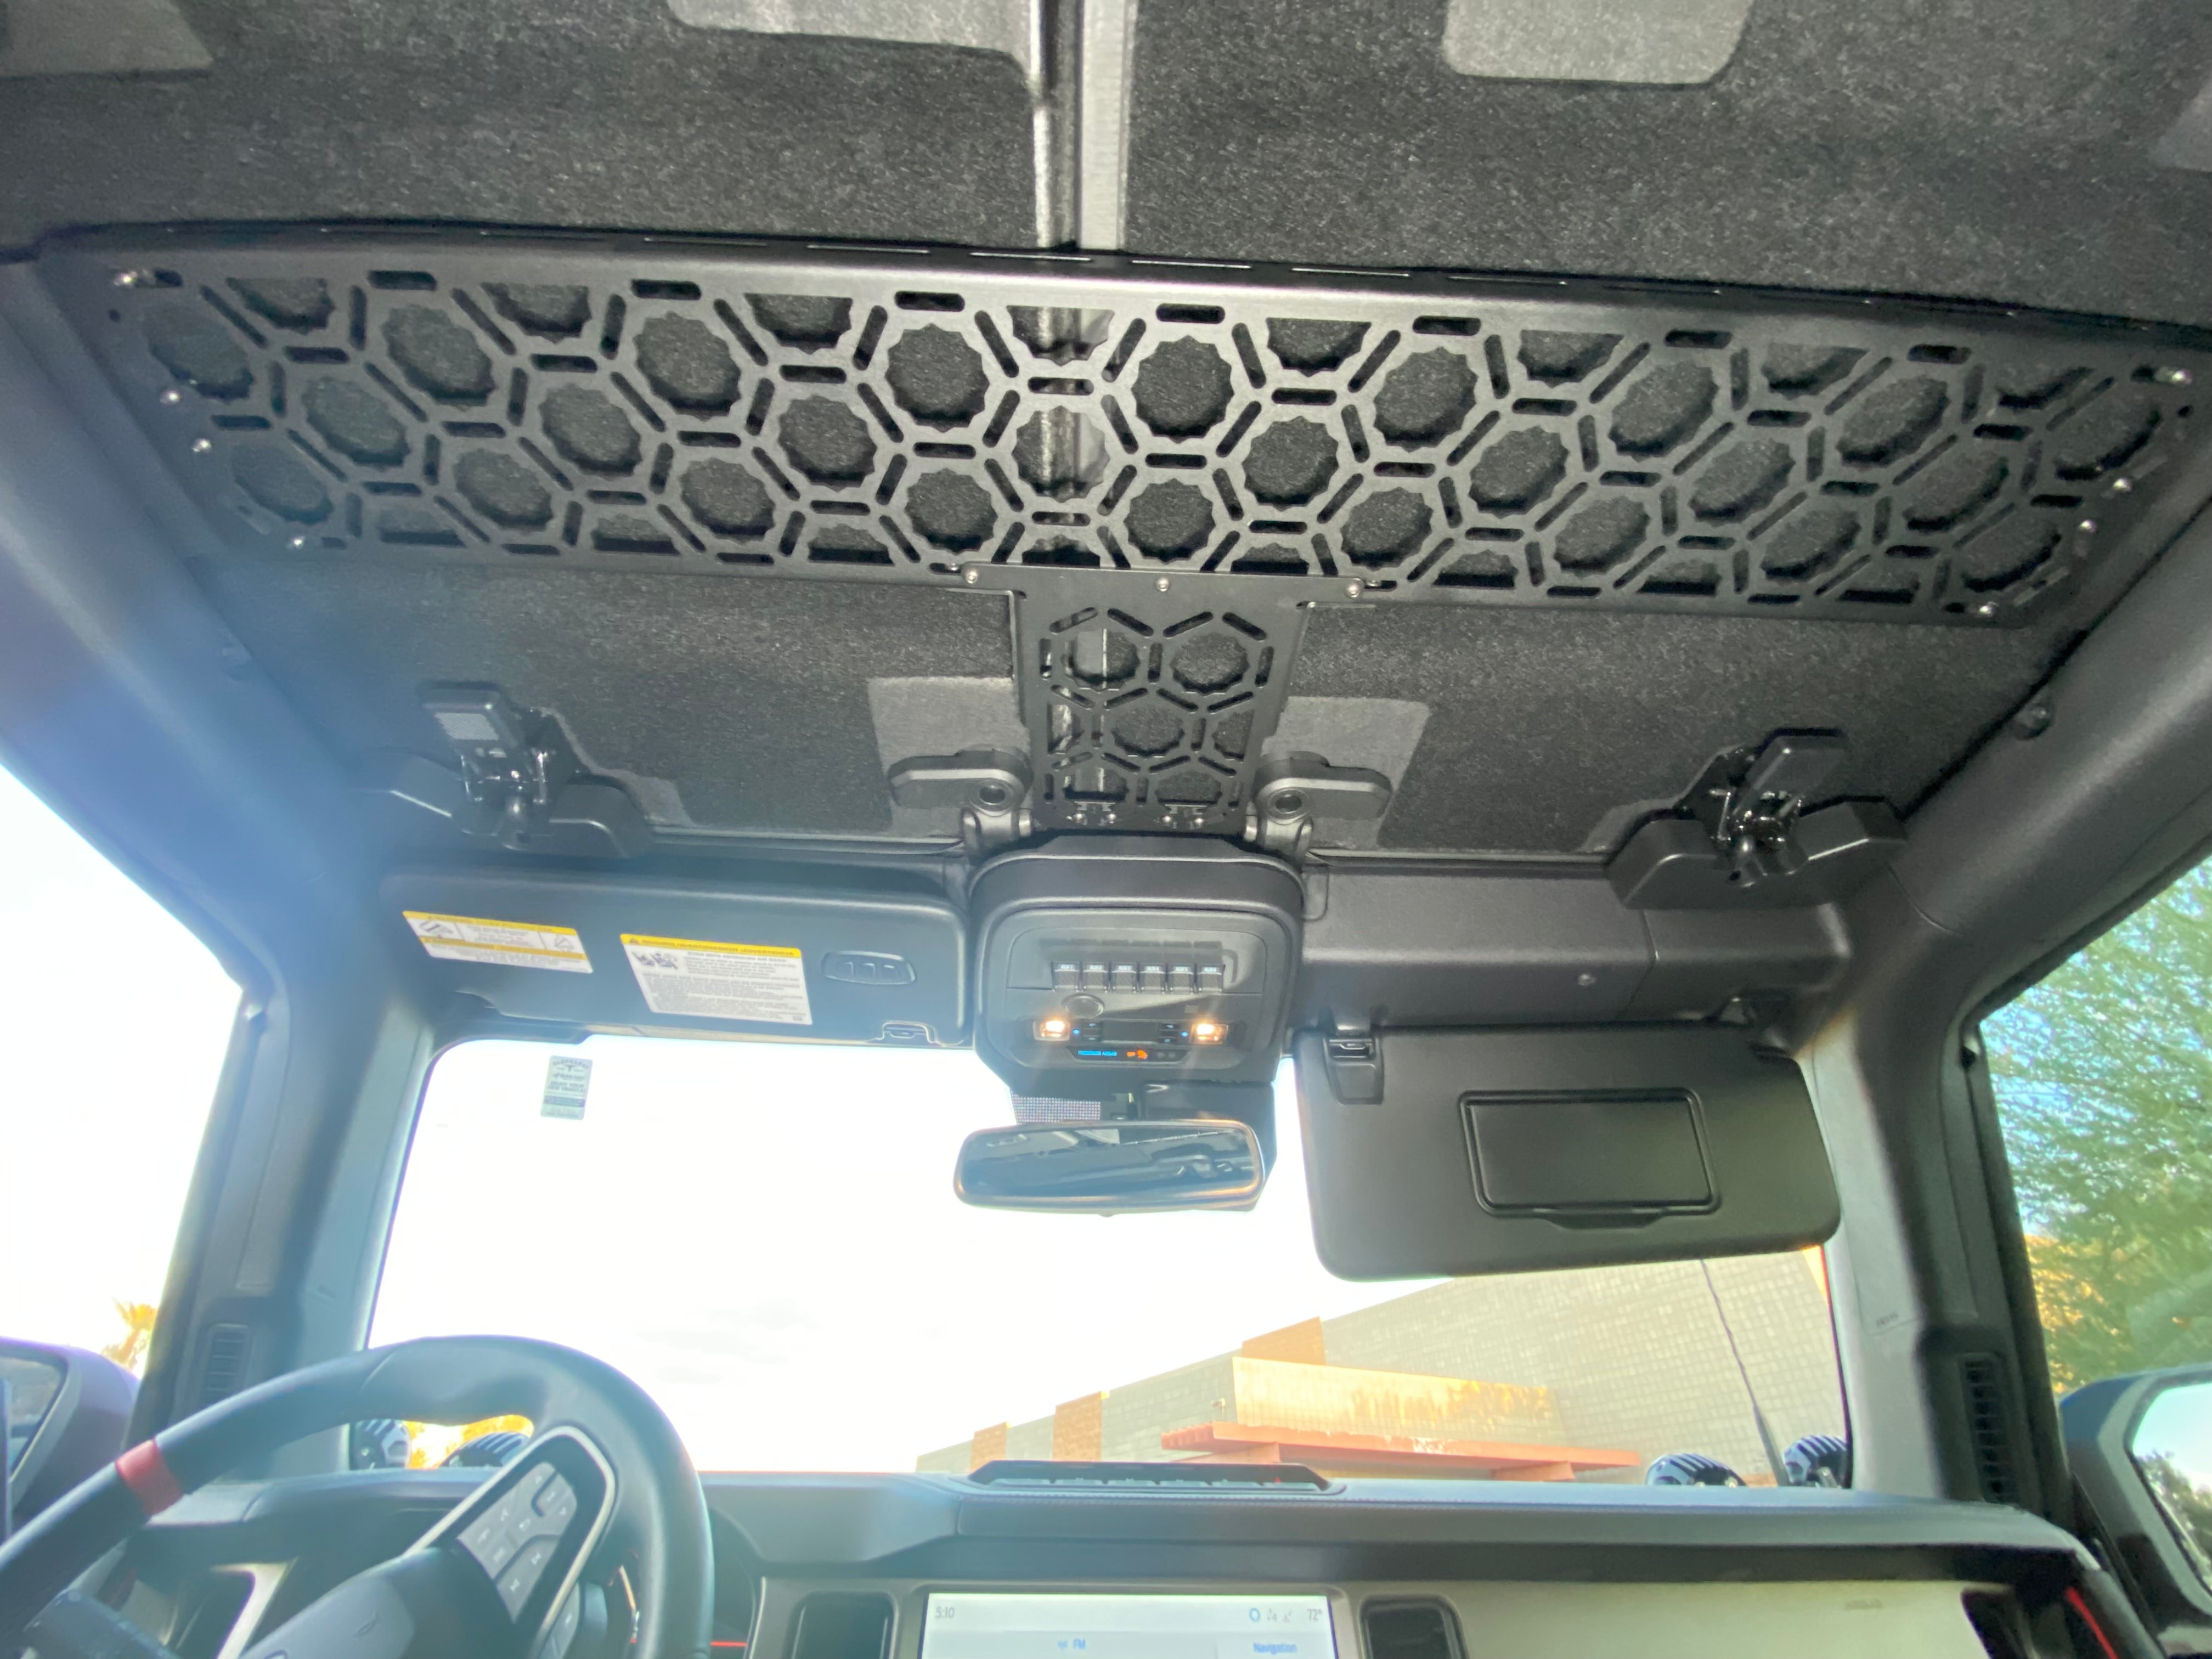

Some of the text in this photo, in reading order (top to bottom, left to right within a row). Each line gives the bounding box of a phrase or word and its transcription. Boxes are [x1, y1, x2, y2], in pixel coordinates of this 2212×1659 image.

[934, 1606, 955, 1618] 5:10
[1073, 1638, 1086, 1649] FM
[1253, 1643, 1298, 1655] Navigation
